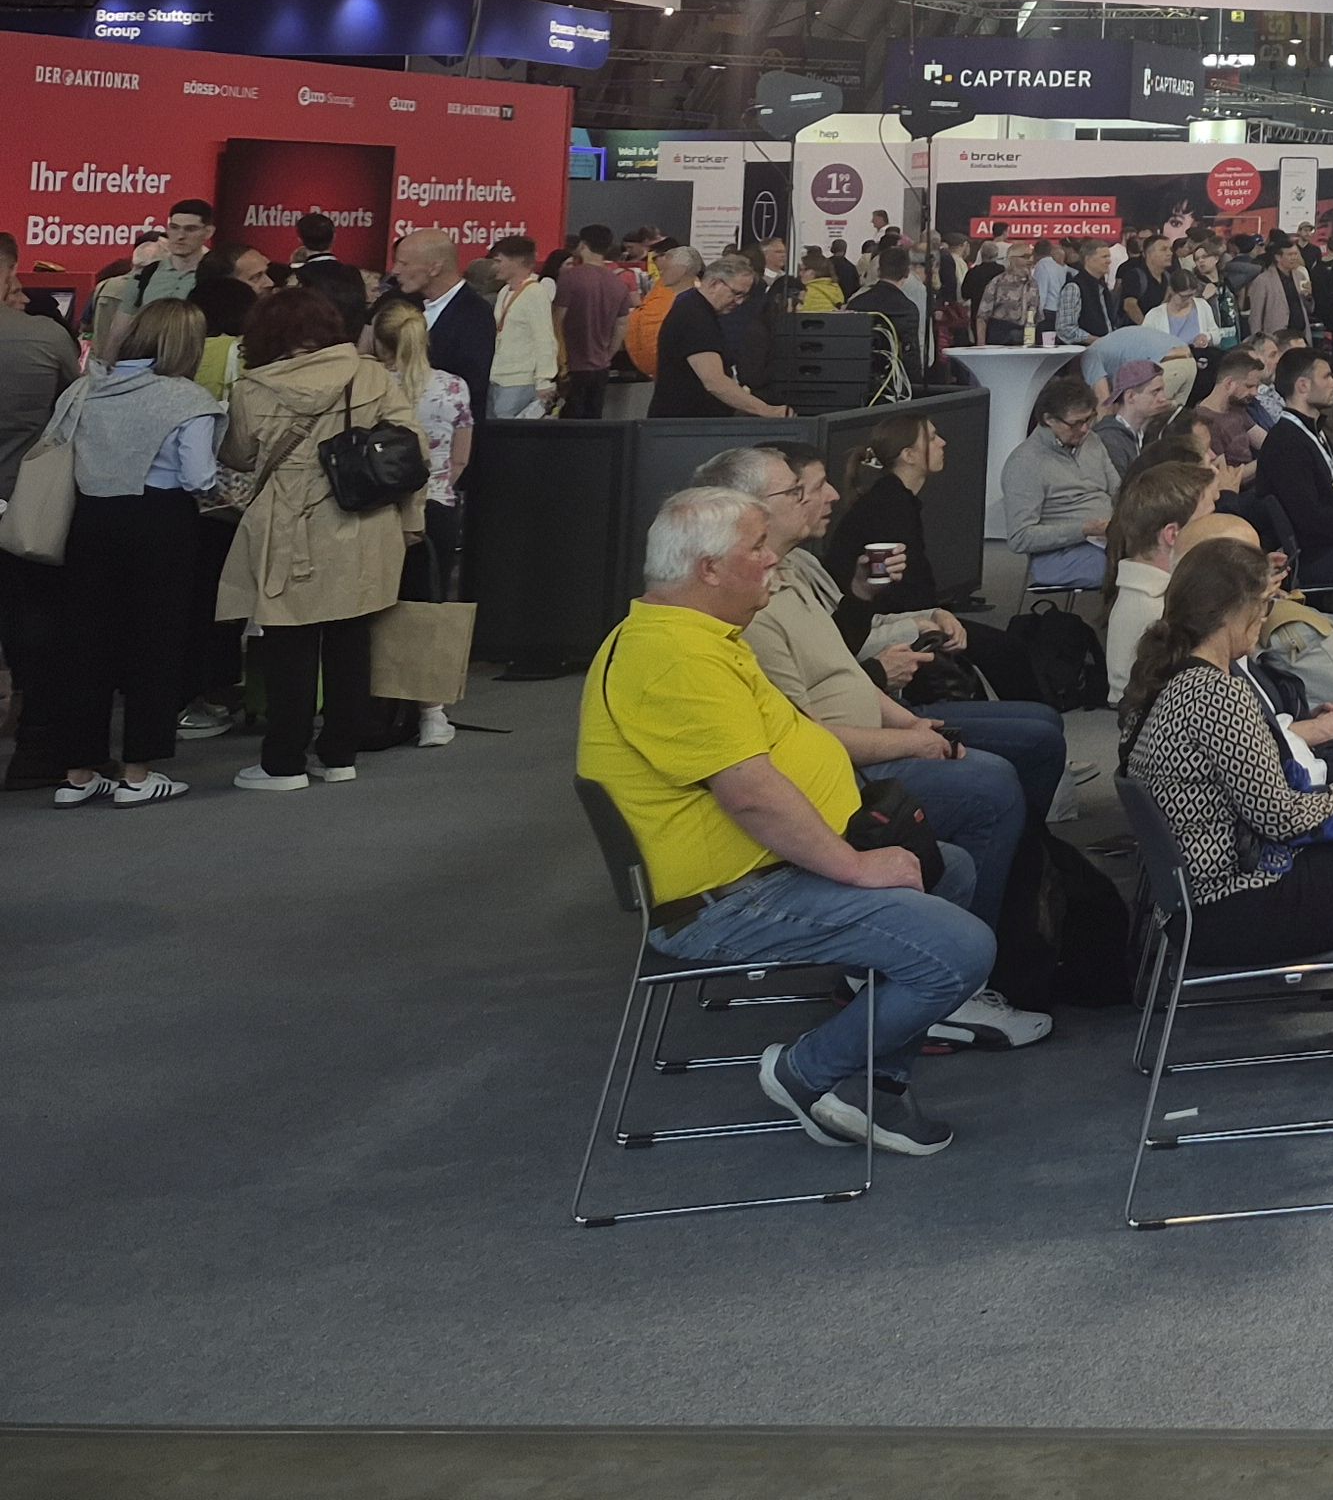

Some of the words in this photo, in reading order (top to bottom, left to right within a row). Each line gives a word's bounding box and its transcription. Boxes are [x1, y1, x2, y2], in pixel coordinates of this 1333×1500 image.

[96, 9, 145, 22] Boerse
[148, 9, 213, 25] Stuttgart
[95, 25, 141, 39] Group
[36, 66, 61, 84] DER
[74, 70, 139, 90] AKTIONÄR
[959, 68, 1092, 90] CAPTRADER
[1154, 75, 1195, 97] CAPTRADER
[221, 85, 258, 99] ONLINE
[819, 130, 839, 140] hep
[683, 154, 729, 163] broker
[971, 152, 1022, 161] broker
[30, 161, 68, 191] Ihr
[72, 162, 171, 194] direkter
[1235, 179, 1249, 187] der
[397, 176, 463, 207] Beginnt
[466, 178, 516, 202] heute.
[1069, 199, 1110, 213] ohne
[463, 221, 486, 244] Sie
[977, 221, 1047, 237] Aung:
[1053, 221, 1117, 235] zocken.
